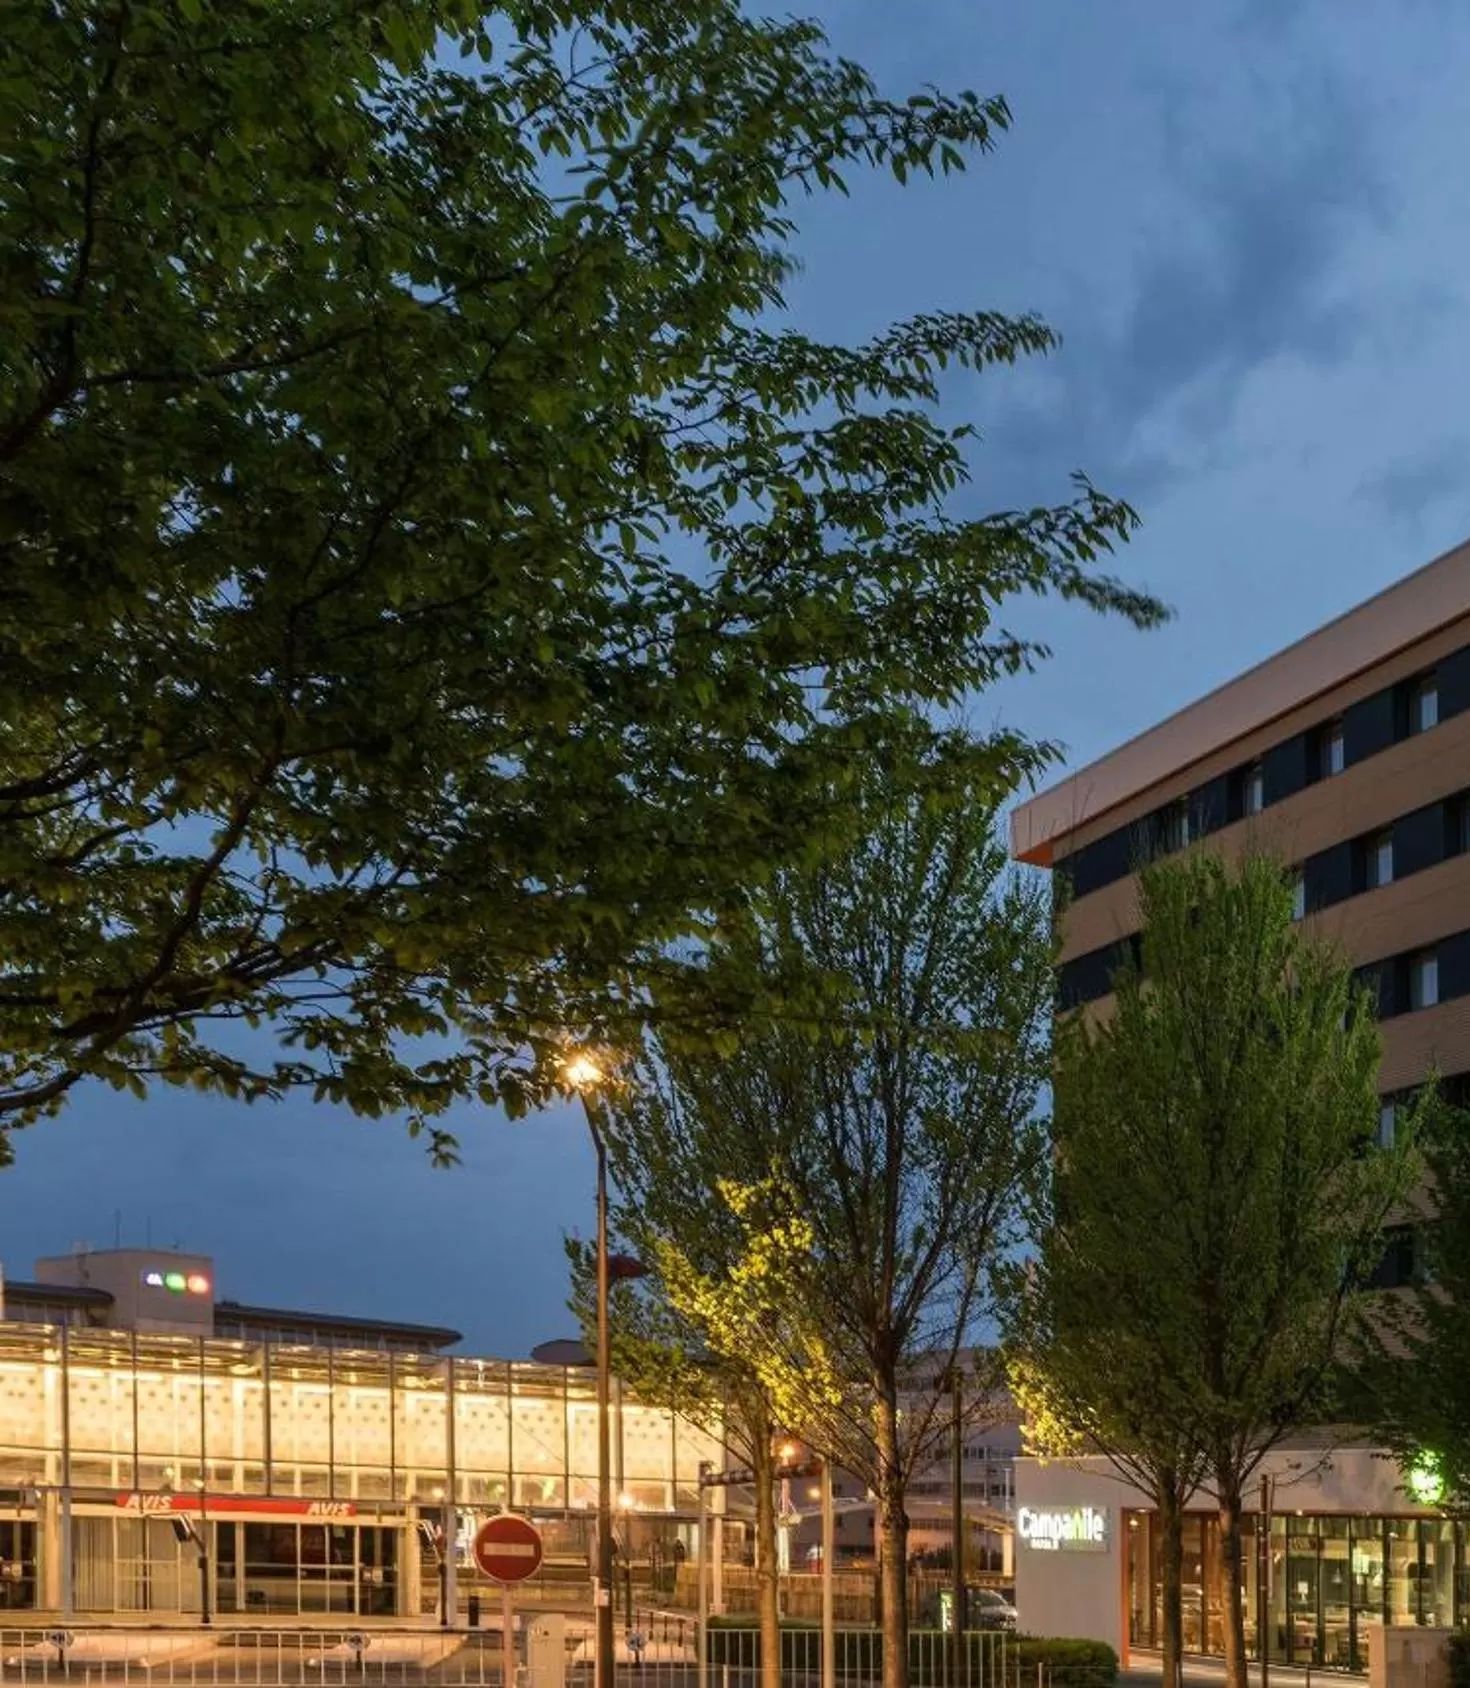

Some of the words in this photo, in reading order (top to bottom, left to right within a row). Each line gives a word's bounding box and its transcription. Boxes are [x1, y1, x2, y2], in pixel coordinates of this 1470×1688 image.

[124, 1494, 172, 1510] AVIS
[306, 1503, 351, 1517] AVIS
[1018, 1507, 1104, 1541] Campanile
